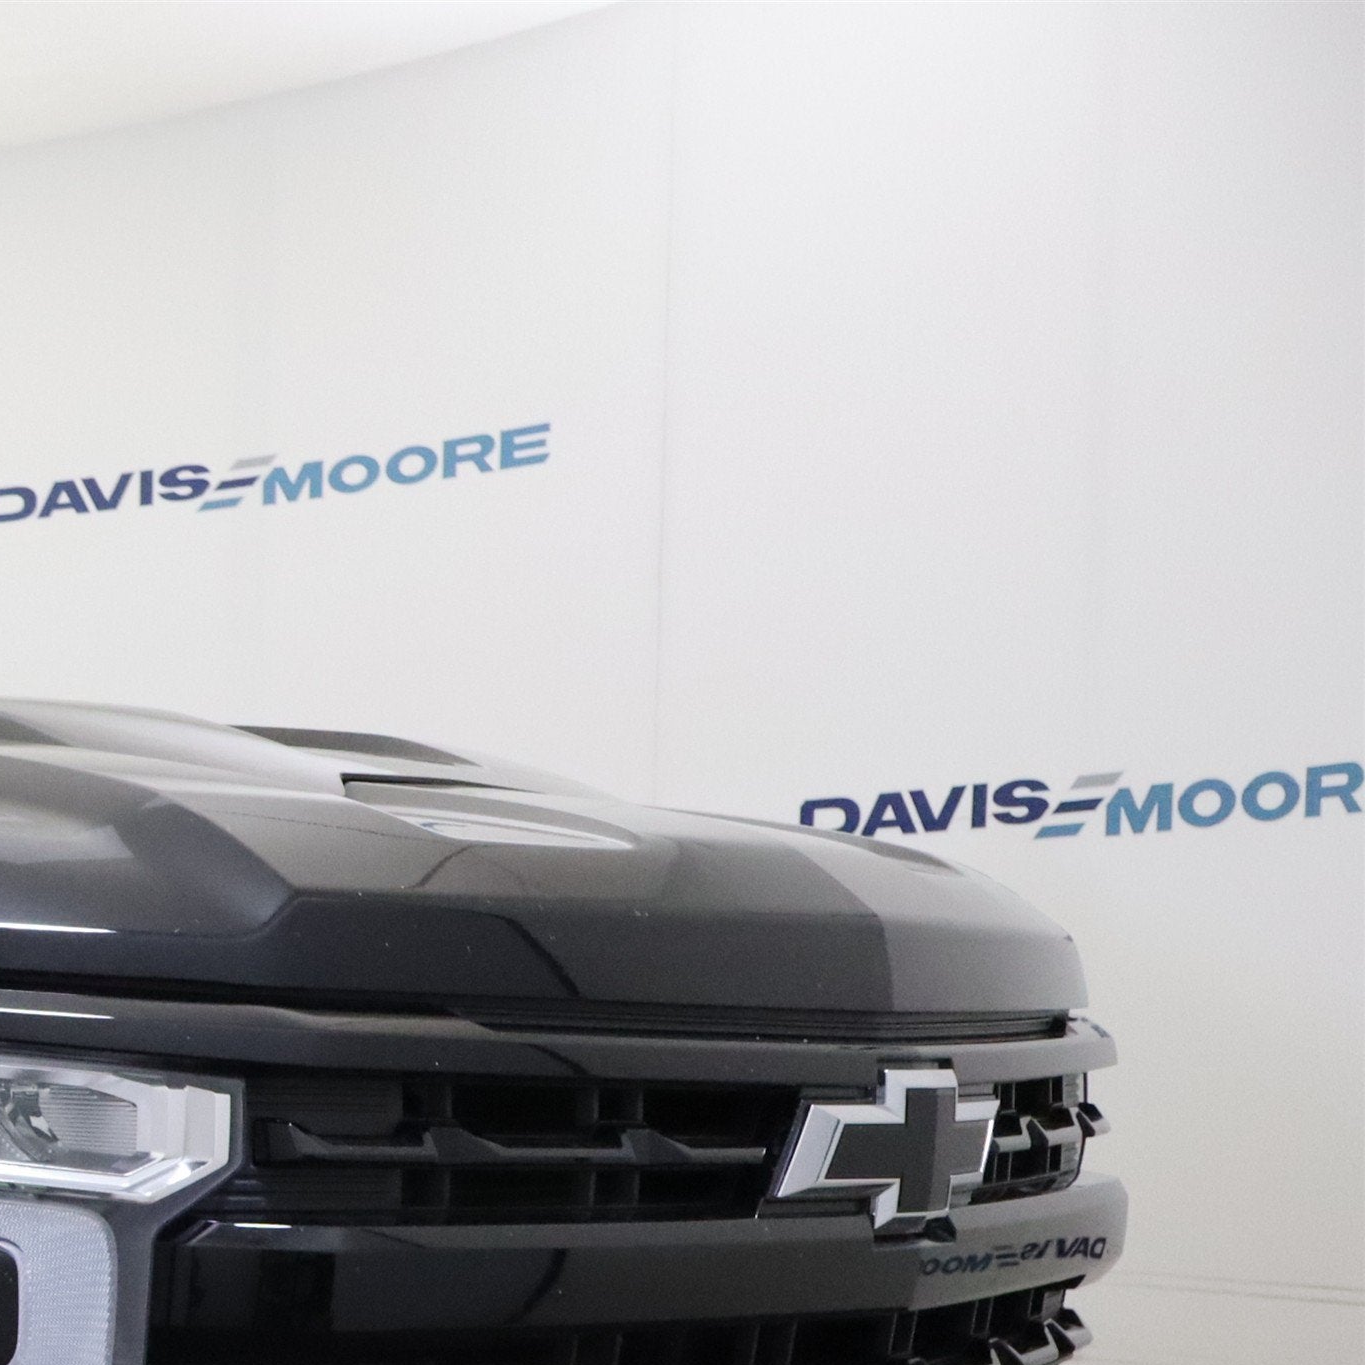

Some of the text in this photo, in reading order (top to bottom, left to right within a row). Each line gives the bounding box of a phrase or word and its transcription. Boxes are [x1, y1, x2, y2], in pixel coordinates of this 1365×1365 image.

[262, 423, 551, 505] MOORE
[799, 761, 1364, 837] DAVIS MOOR
